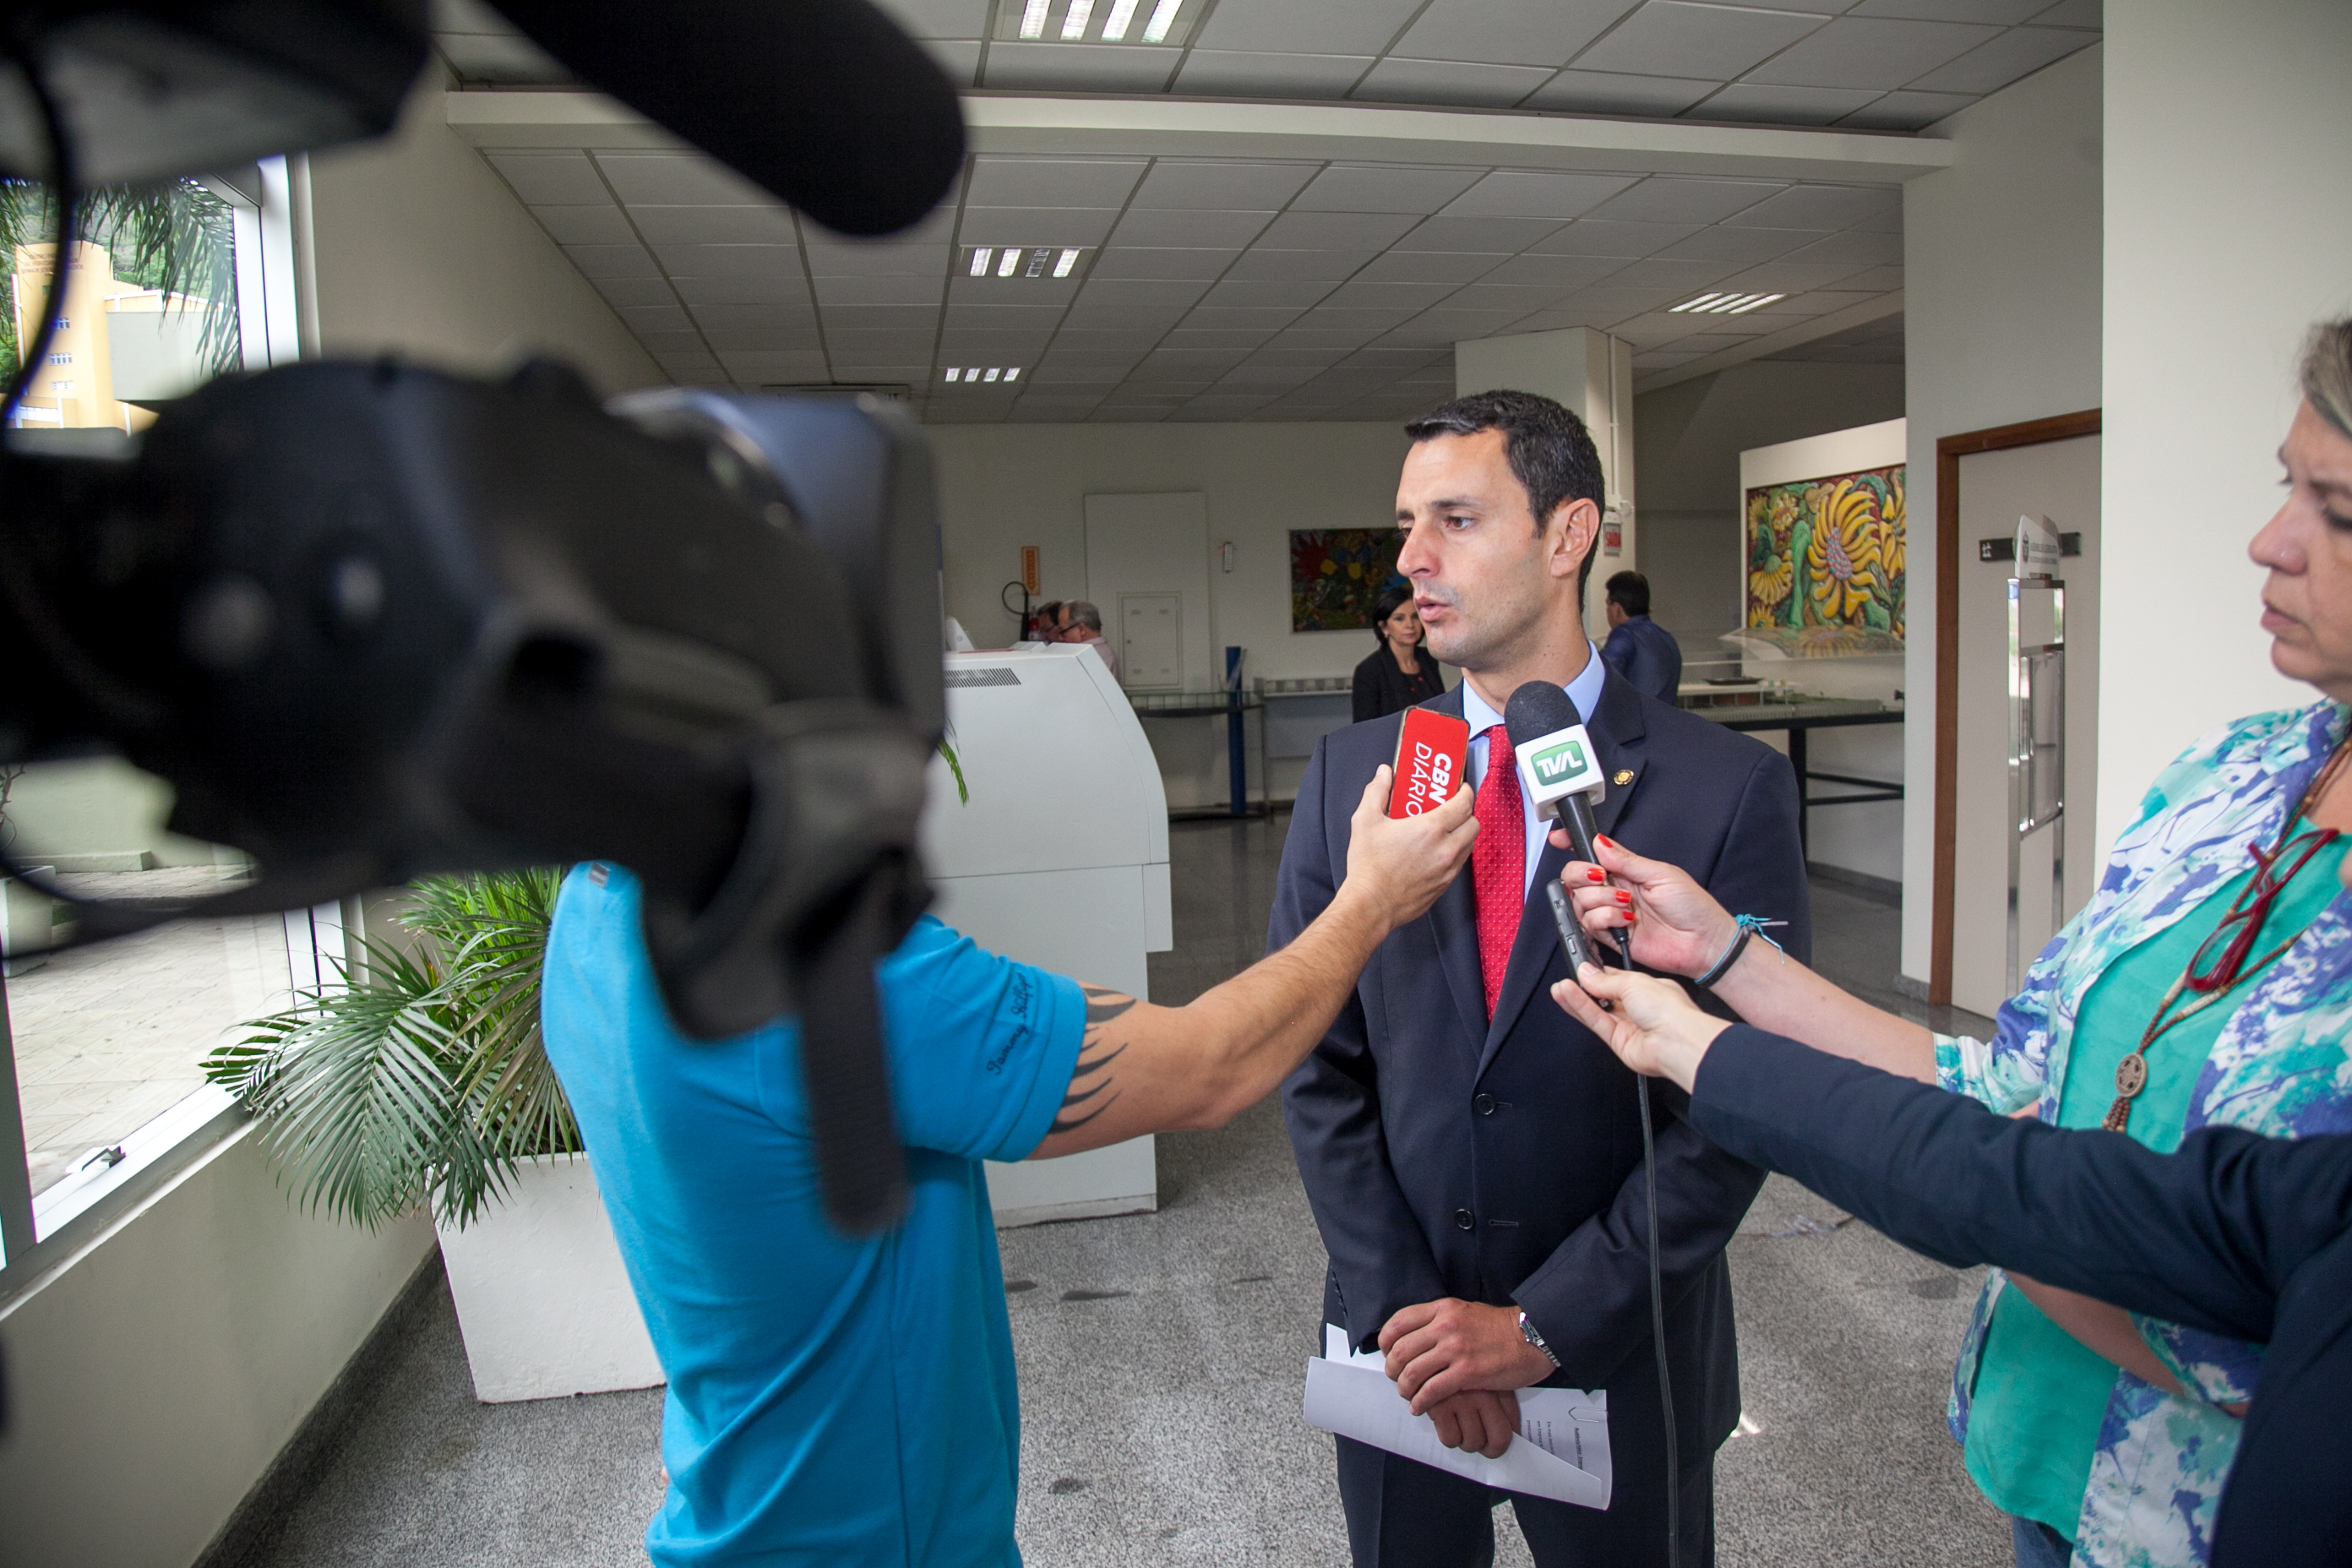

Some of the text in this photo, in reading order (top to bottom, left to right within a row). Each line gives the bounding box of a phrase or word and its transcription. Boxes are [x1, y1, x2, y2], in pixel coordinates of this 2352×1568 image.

[1405, 741, 1432, 817] DIÁRIO
[1429, 753, 1452, 804] CBN
[985, 1024, 1029, 1075] Tommy
